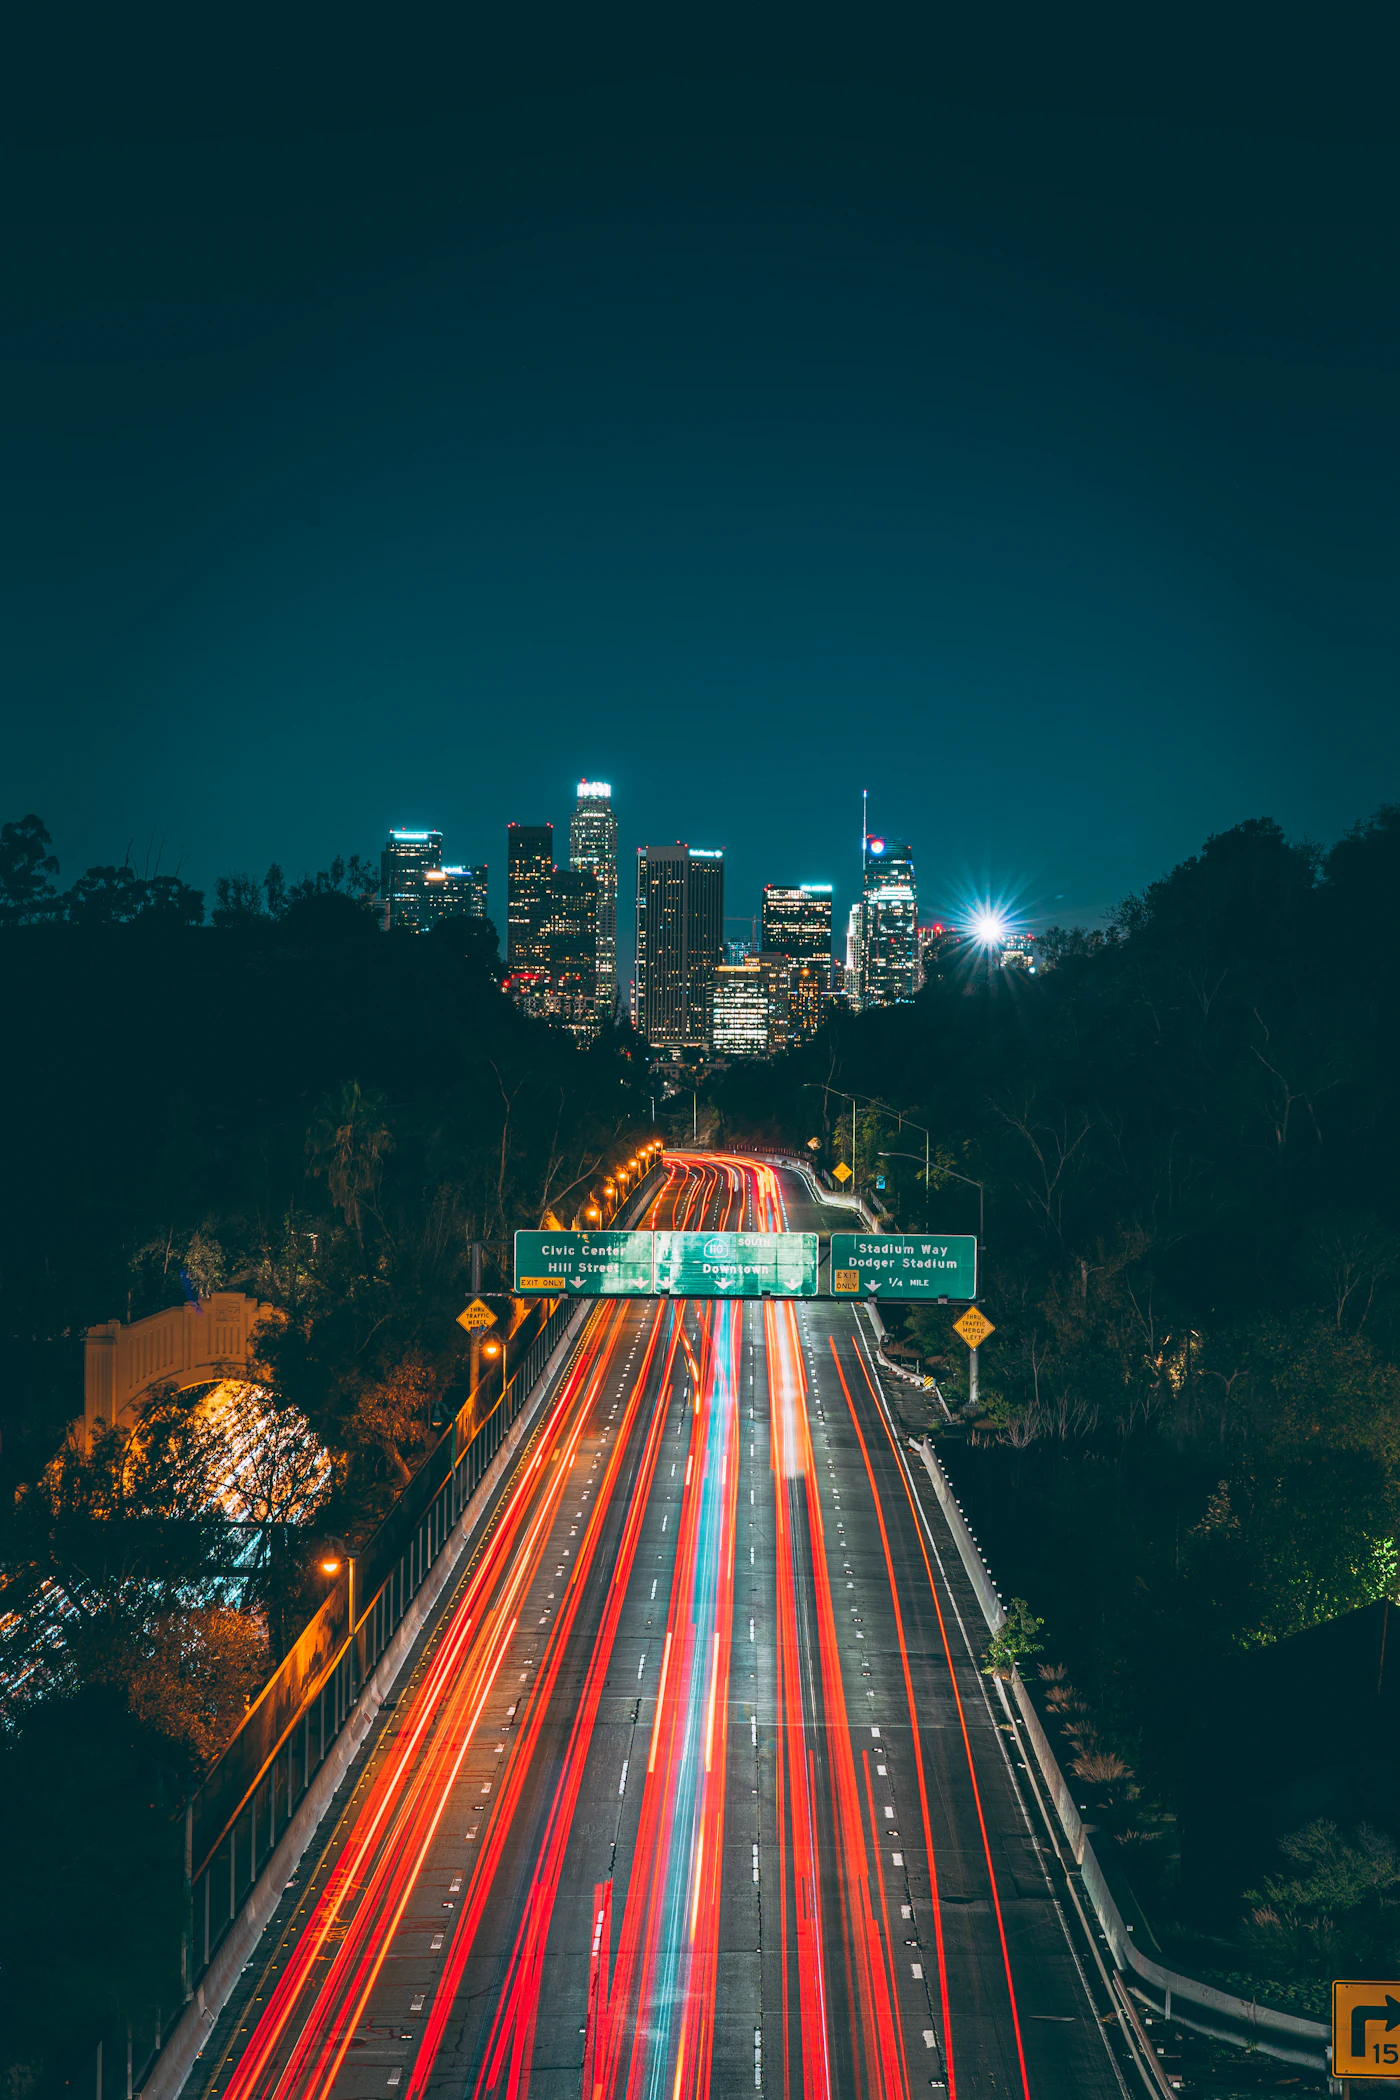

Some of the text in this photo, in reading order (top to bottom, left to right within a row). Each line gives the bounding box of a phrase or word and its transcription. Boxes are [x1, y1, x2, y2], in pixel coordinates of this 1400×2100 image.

[738, 1238, 770, 1246] SOUTH
[541, 1245, 626, 1256] Civic Center
[709, 1244, 723, 1254] 110
[859, 1243, 948, 1257] Stadium Way
[548, 1262, 619, 1273] Hill Street
[703, 1263, 769, 1274] Downtown
[848, 1257, 957, 1270] Dodger Stadium
[837, 1271, 857, 1279] EXIT
[542, 1279, 564, 1287] ONLY
[836, 1282, 857, 1290] ONLY
[909, 1279, 929, 1287] MILE
[1373, 2043, 1399, 2065] 15
